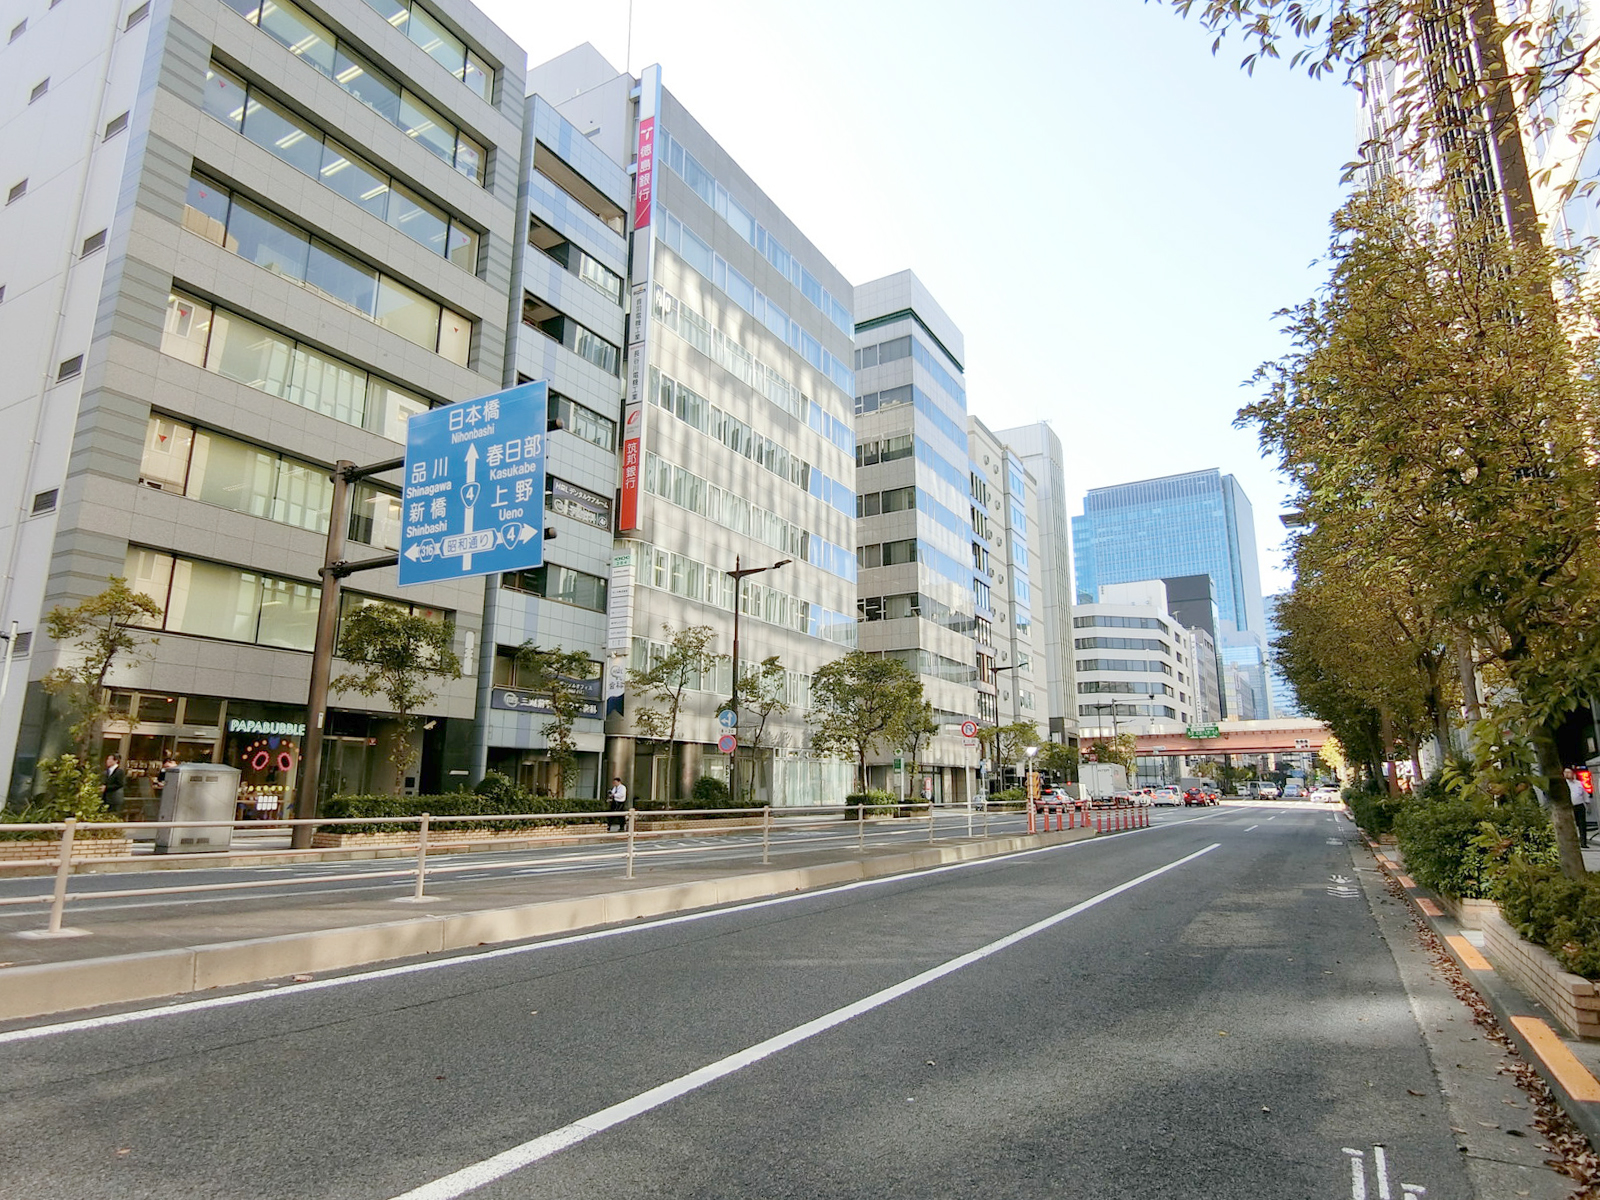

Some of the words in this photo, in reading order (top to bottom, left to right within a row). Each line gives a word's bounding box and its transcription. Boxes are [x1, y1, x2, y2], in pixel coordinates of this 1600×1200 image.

[638, 143, 652, 202] 徳島銀行
[449, 399, 500, 431] 日本橋
[451, 424, 495, 444] Nihonbashi
[486, 434, 541, 467] 春日部
[411, 456, 449, 484] 品川
[489, 461, 536, 481] Kasukabe
[625, 442, 638, 489] 筑邦銀行
[406, 479, 452, 499] Shinagawa
[465, 489, 474, 501] 4
[491, 478, 534, 508] 上野
[408, 496, 447, 523] 新橋
[498, 507, 524, 522] Ueno
[406, 520, 448, 539] Shinbashi
[506, 526, 515, 541] 4
[420, 544, 434, 557] 316
[446, 535, 490, 553] 昭和通り
[229, 718, 306, 736] PAPABUBBLE
